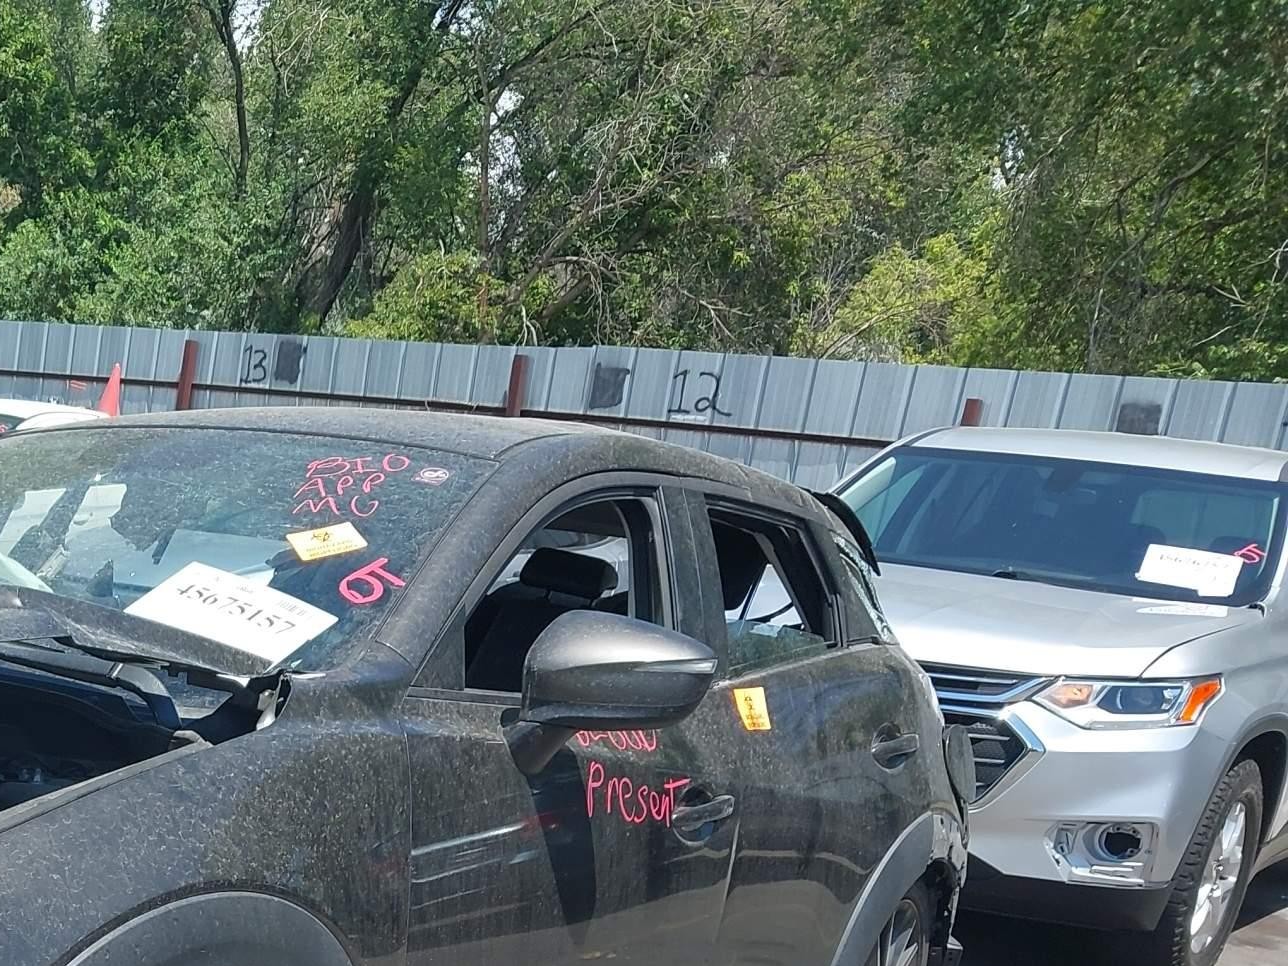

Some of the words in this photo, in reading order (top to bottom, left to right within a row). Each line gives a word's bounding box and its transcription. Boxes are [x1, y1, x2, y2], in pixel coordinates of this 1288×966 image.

[240, 344, 267, 383] 13
[667, 369, 732, 416] 12
[293, 472, 385, 498] APP
[306, 453, 411, 478] BIO
[176, 584, 296, 634] 45675157
